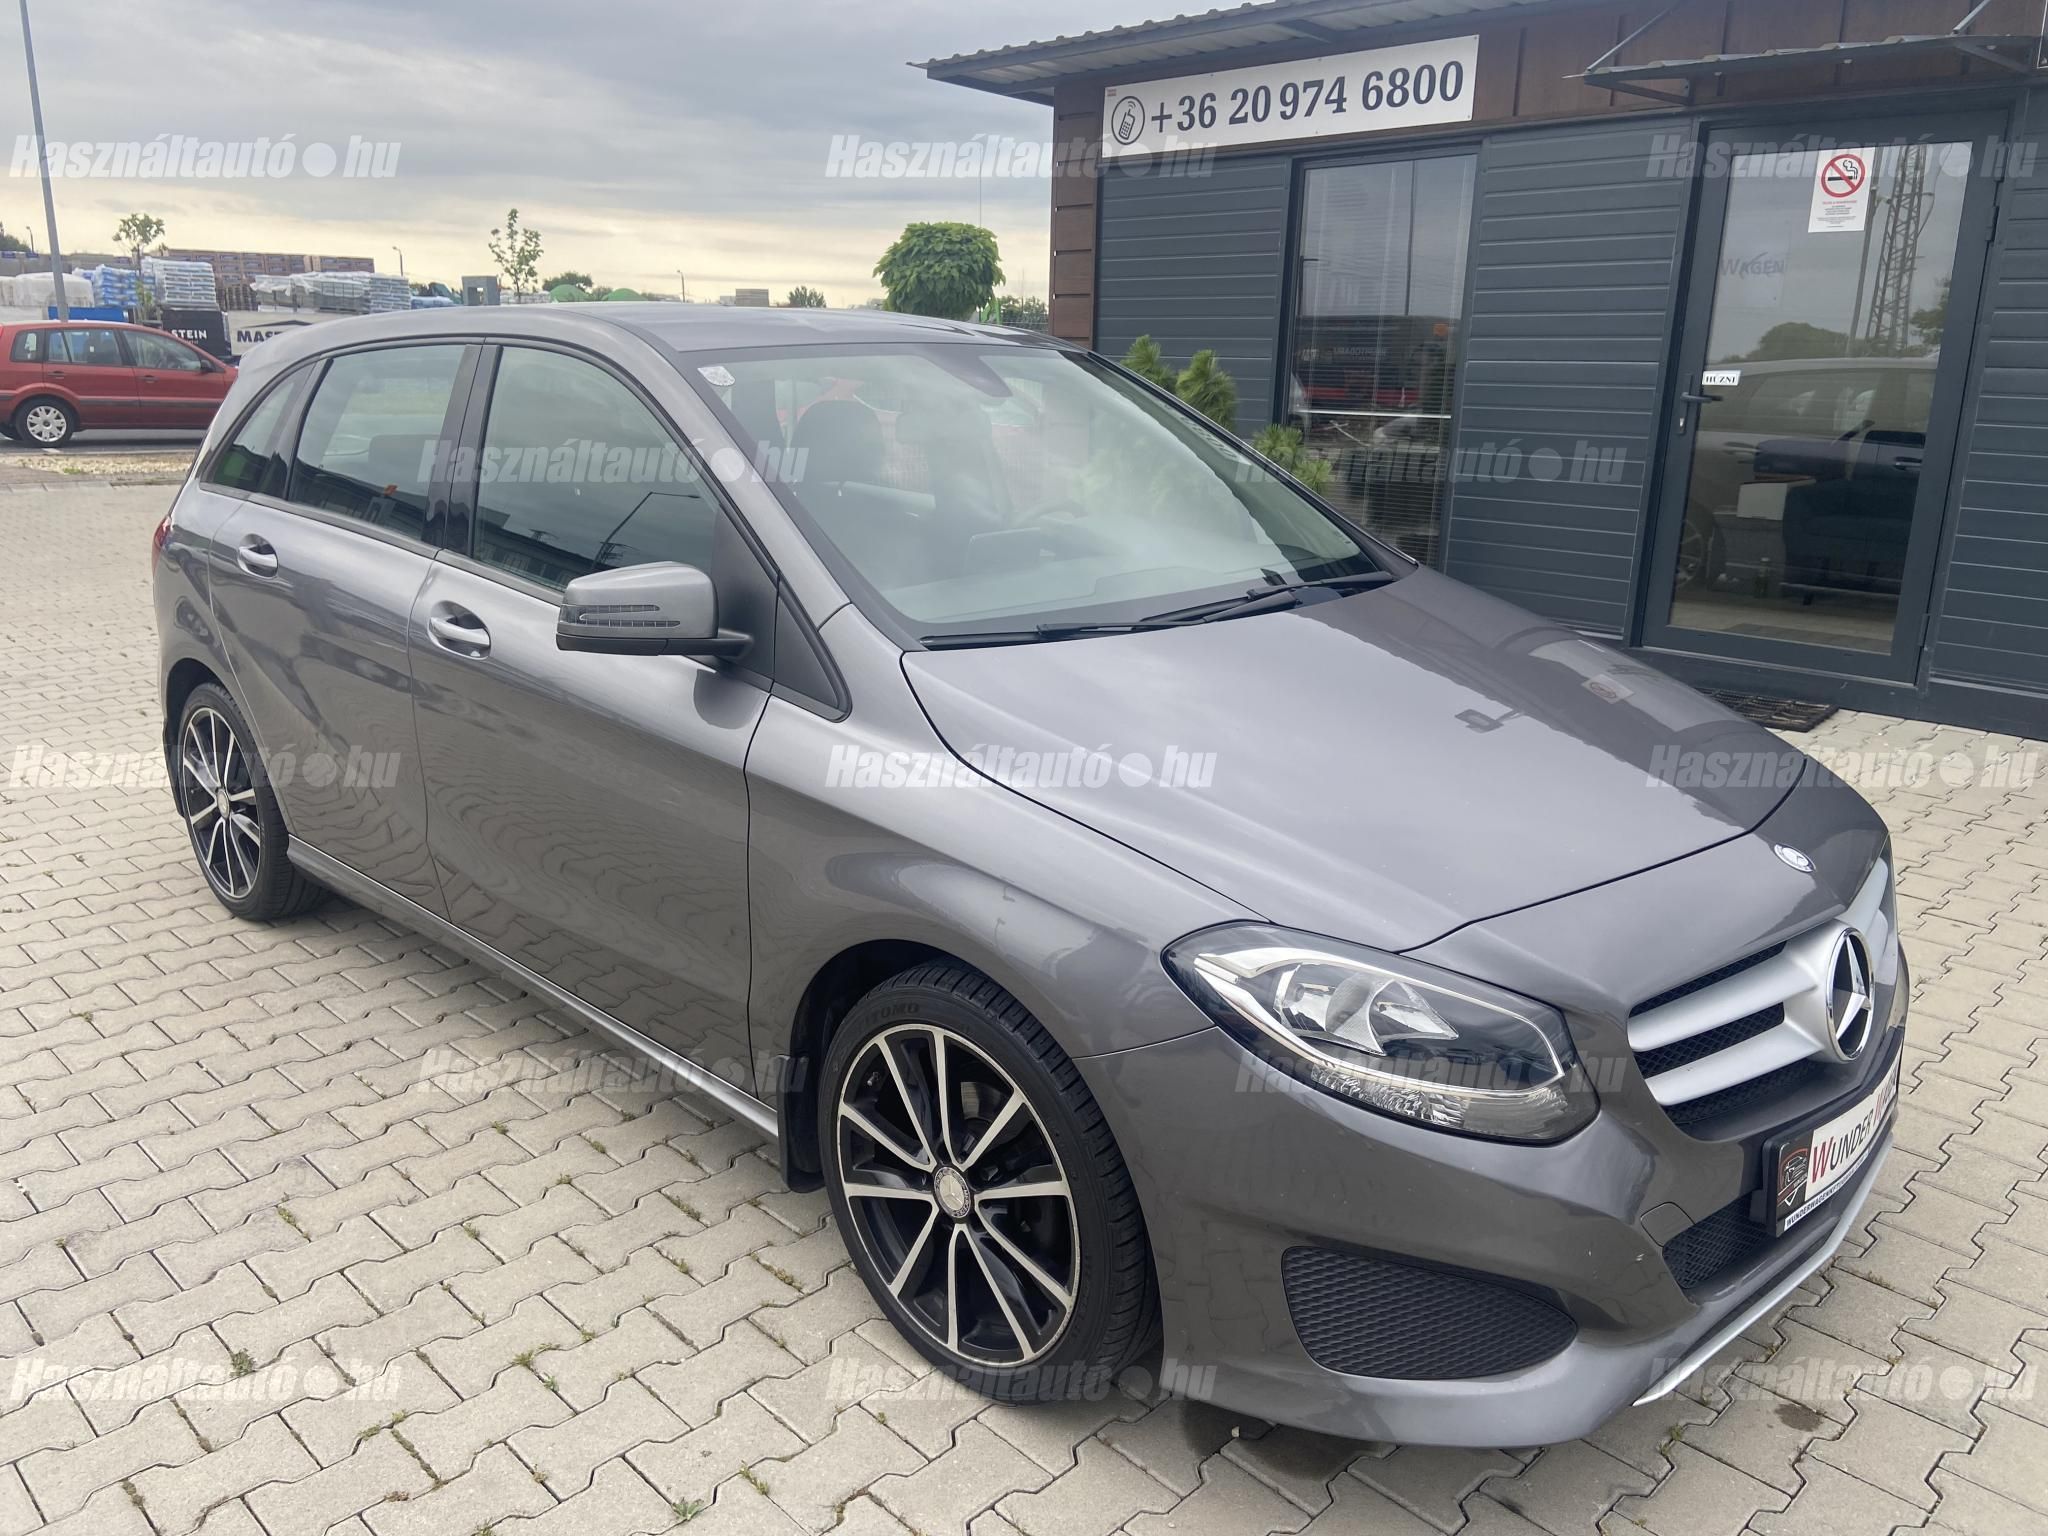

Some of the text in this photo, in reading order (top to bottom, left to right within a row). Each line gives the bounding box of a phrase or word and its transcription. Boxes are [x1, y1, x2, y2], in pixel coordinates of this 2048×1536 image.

[1151, 60, 1464, 133] +36 20 974 6800
[1811, 1108, 1874, 1183] WUNDER
